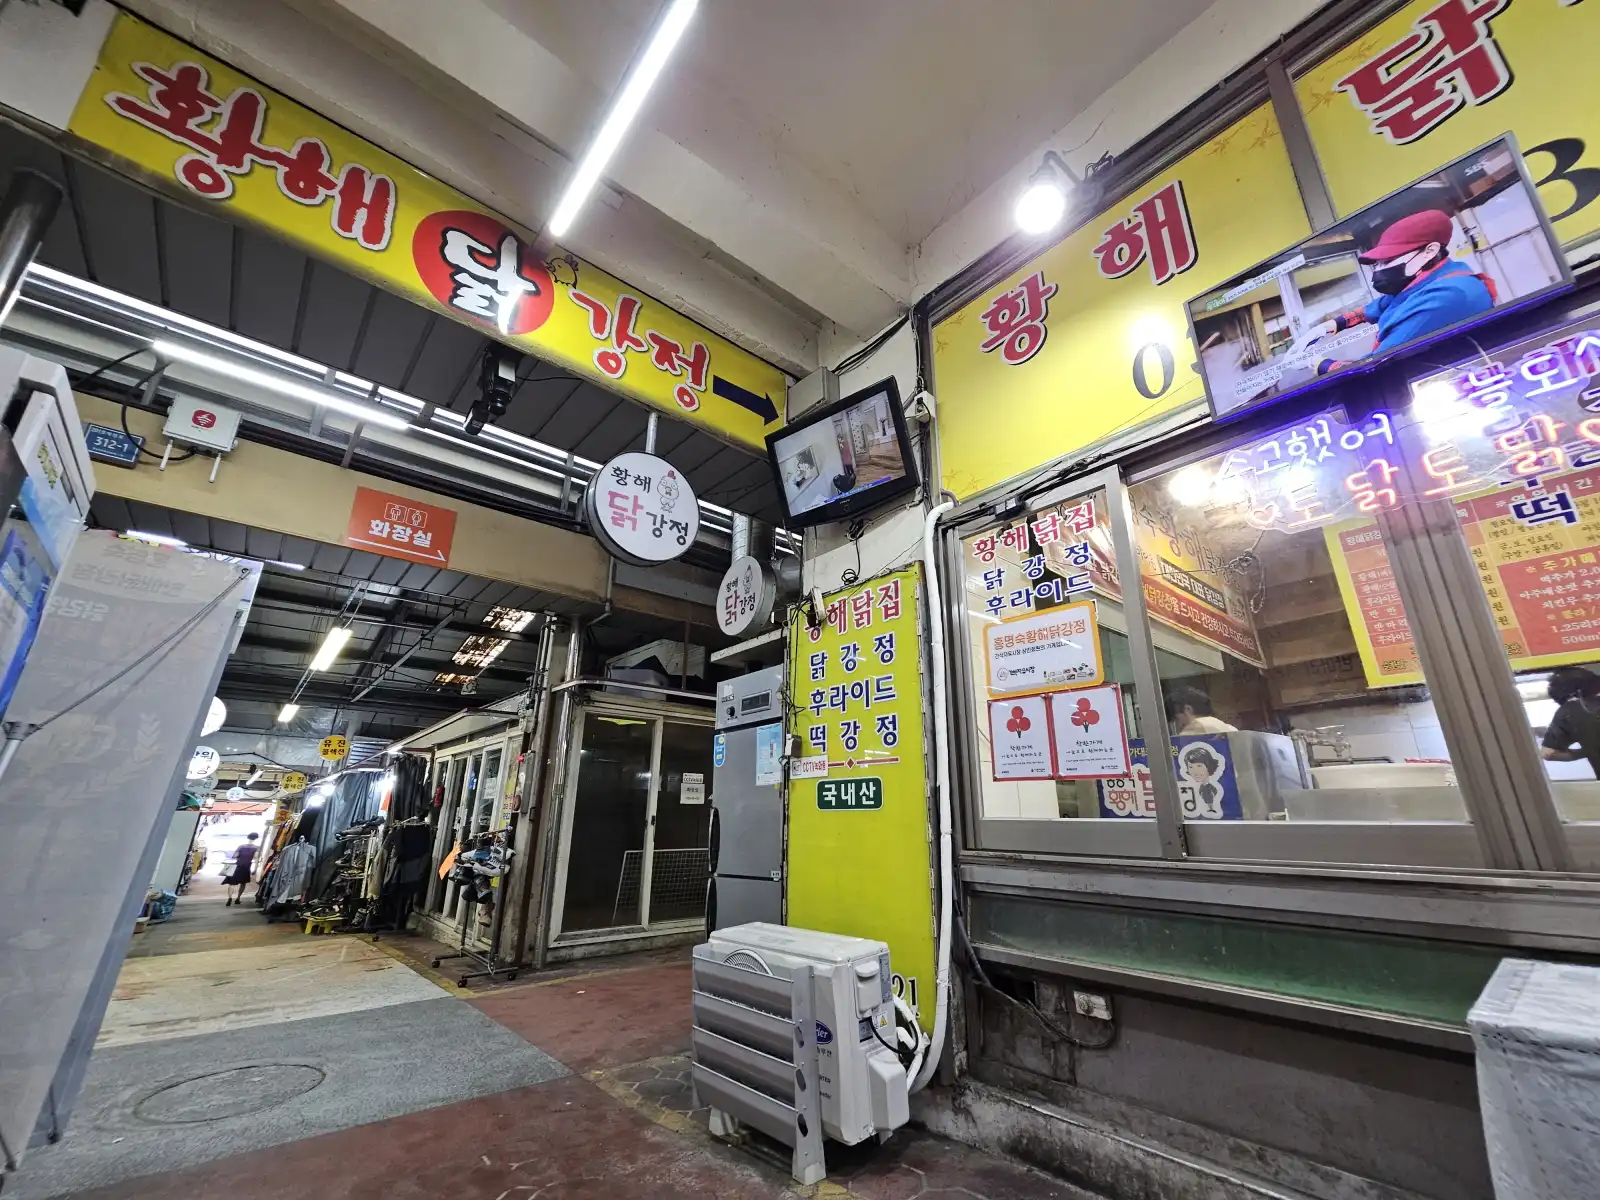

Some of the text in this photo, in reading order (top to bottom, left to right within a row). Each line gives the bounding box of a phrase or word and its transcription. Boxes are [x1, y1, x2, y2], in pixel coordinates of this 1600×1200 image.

[104, 60, 397, 252] 황해
[93, 435, 129, 453] 312-1
[609, 464, 652, 493] 황해
[368, 518, 433, 548] 화장실
[972, 499, 1096, 564] 황해닭집
[984, 572, 1094, 617] 후라이드
[809, 674, 897, 718] 후라이드
[821, 783, 877, 806] 국내산
